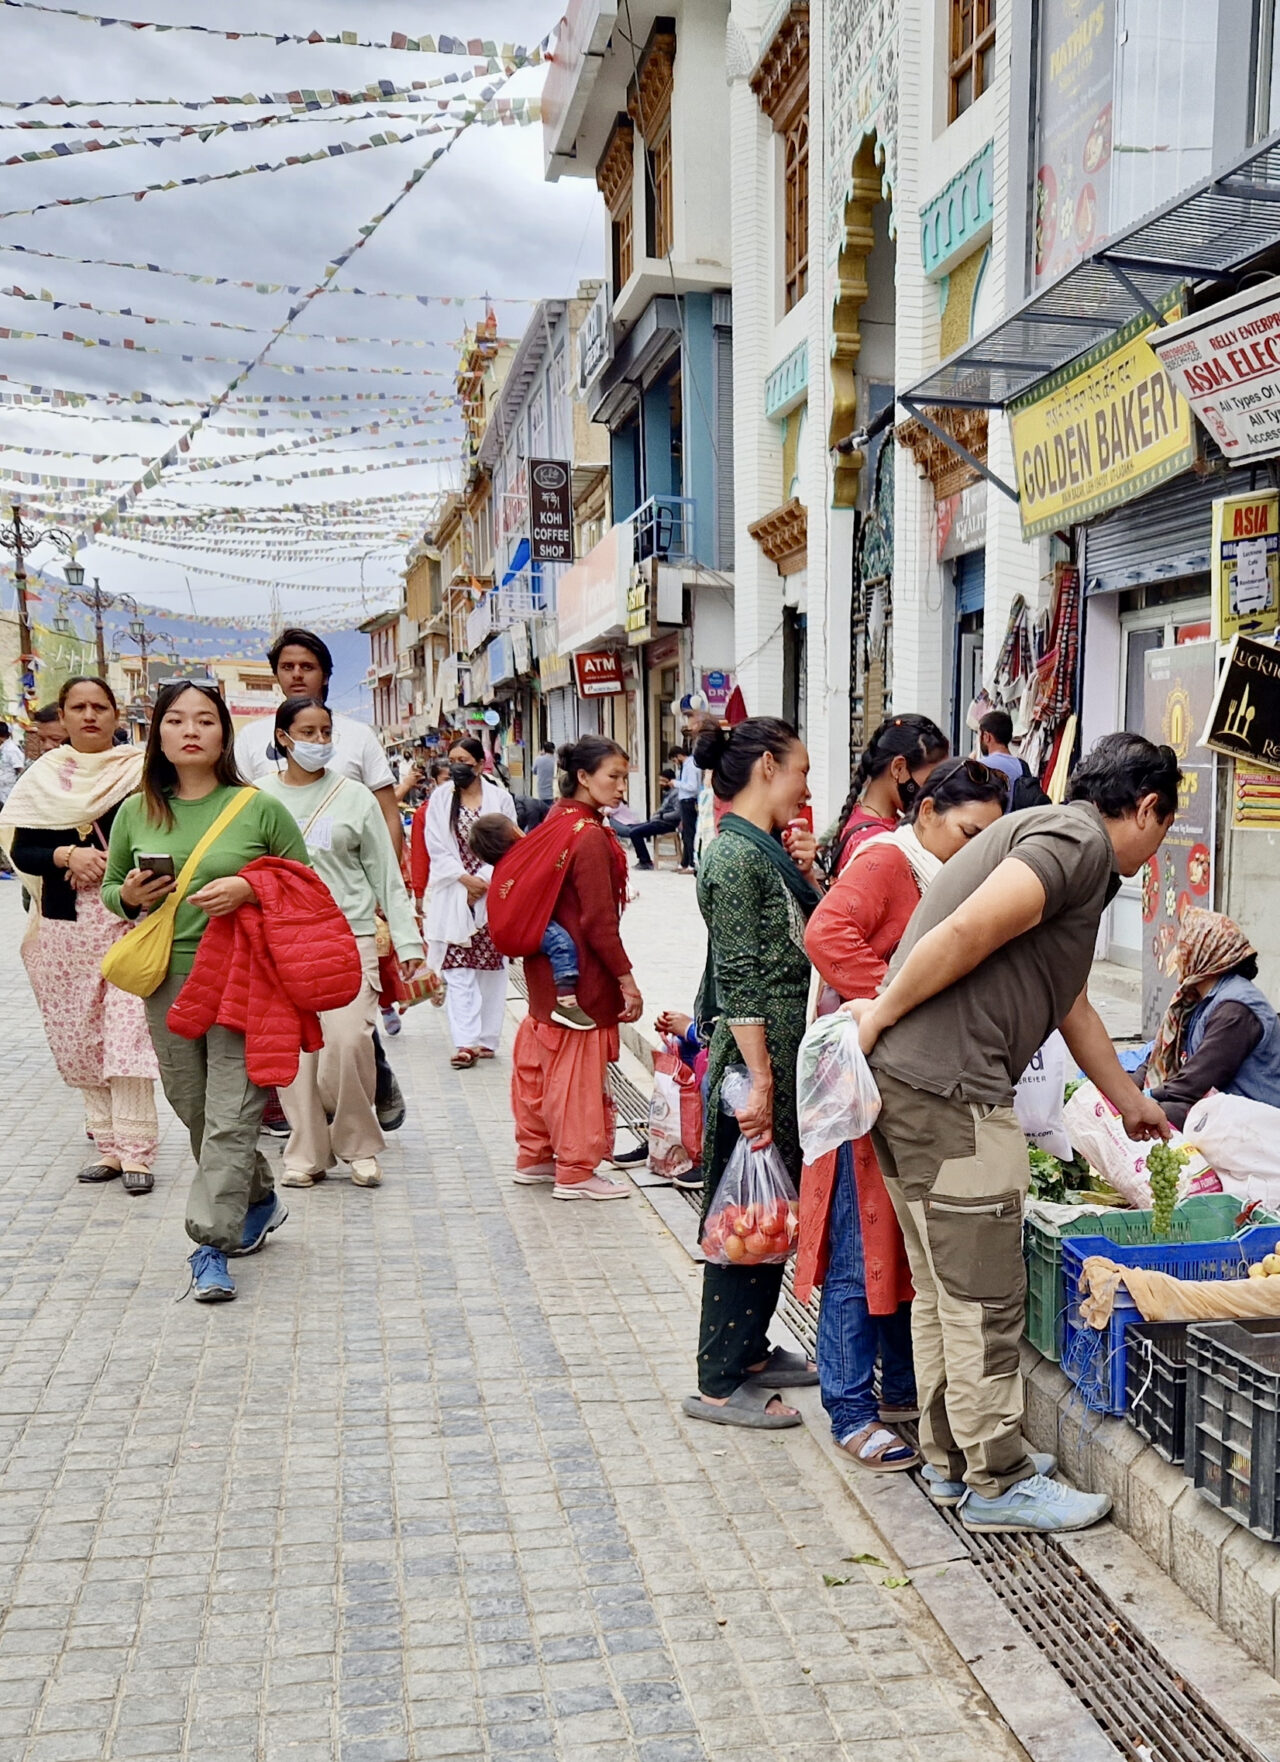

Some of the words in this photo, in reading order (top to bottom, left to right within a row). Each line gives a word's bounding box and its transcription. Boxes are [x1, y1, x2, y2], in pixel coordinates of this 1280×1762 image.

[1210, 330, 1237, 351] RELLY
[1183, 355, 1232, 395] ASIA
[1219, 399, 1231, 413] All
[1231, 391, 1261, 414] Types
[1261, 384, 1274, 399] Of
[1249, 412, 1264, 427] All
[1022, 418, 1092, 505] GOLDEN
[1095, 372, 1179, 472] BAKERY
[540, 512, 562, 525] KOHI
[1233, 504, 1268, 536] ASIA
[534, 527, 569, 542] COFFEE
[540, 544, 564, 558] SHOP
[584, 658, 616, 673] ATM
